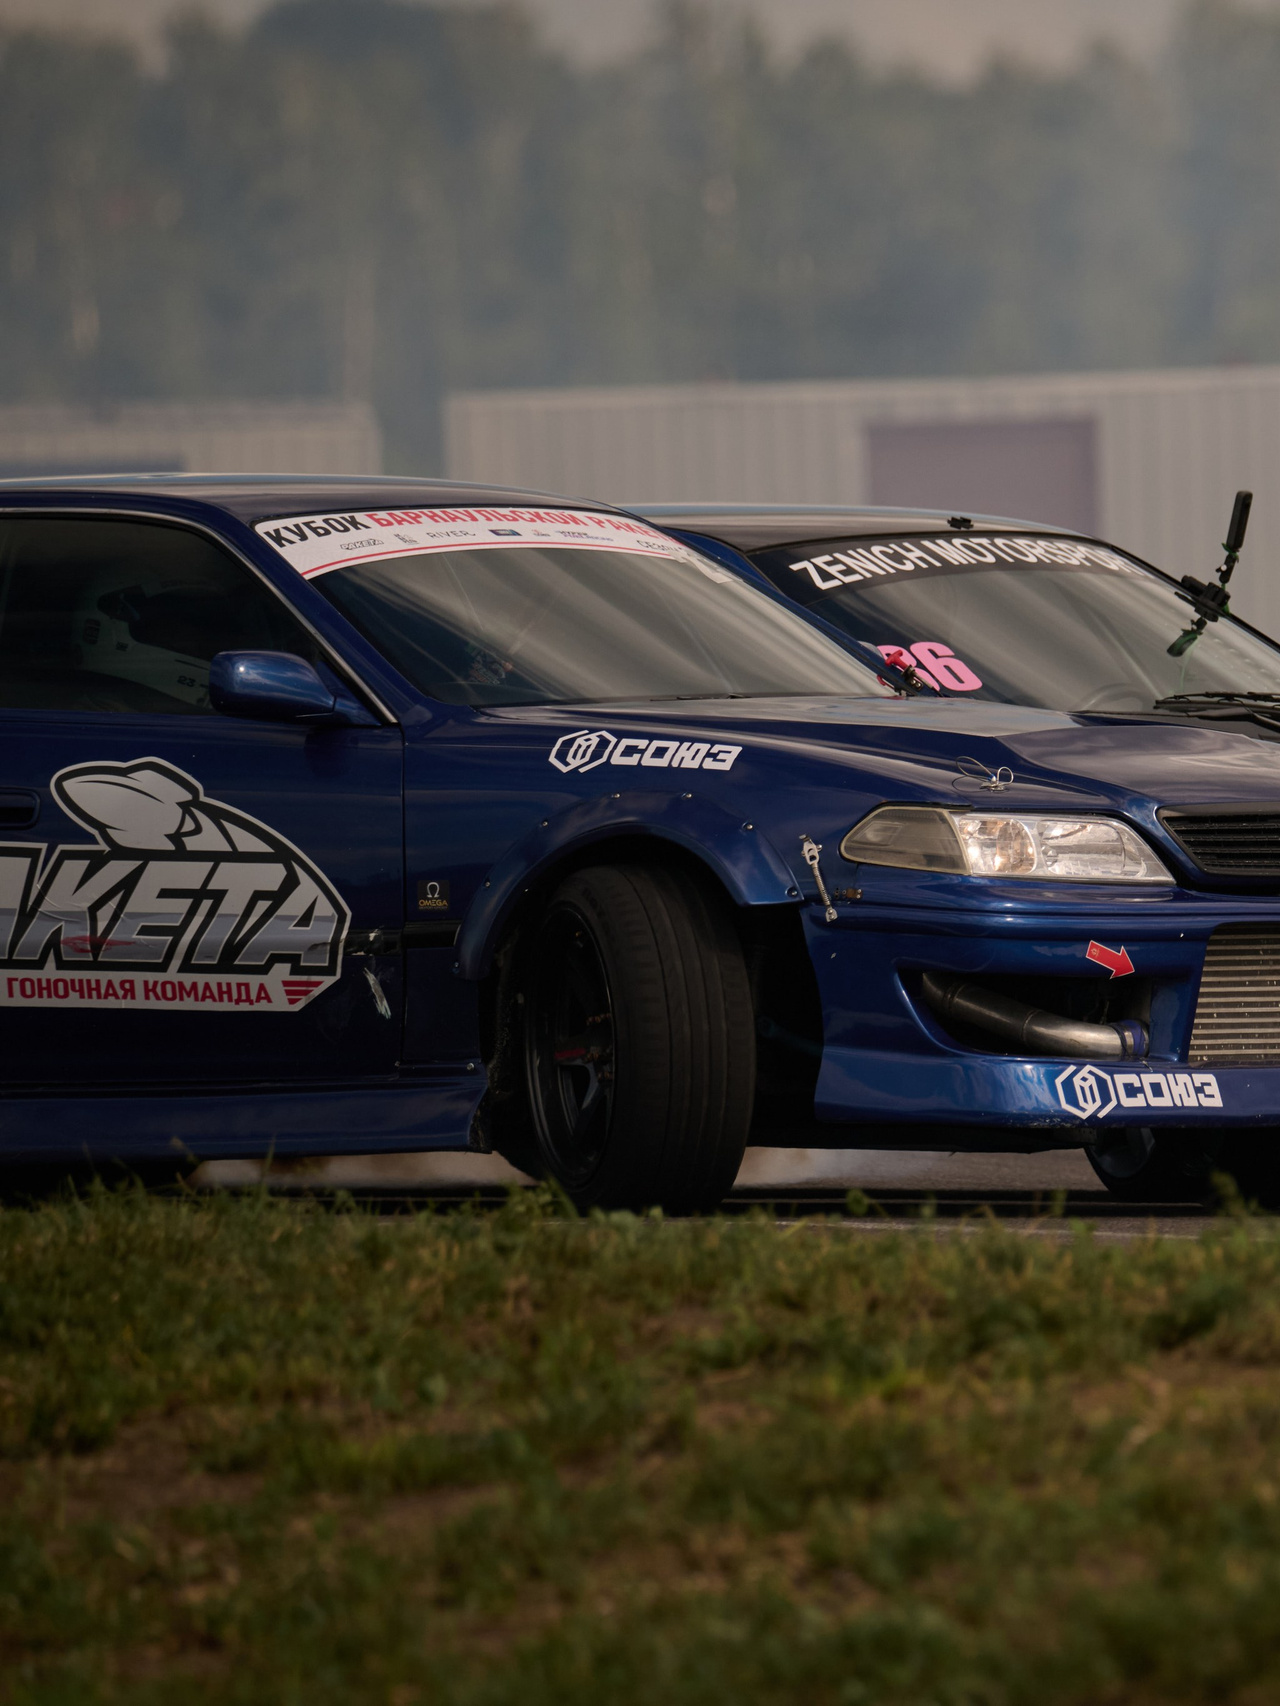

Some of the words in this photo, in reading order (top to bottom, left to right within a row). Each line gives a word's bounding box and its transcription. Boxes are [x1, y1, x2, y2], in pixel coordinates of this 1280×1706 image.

[263, 514, 372, 548] КУБОК
[365, 508, 588, 528] БАРНАУЛЬСКОЙ
[789, 541, 942, 590] ZENICH
[921, 537, 1155, 579] MOTORSPORT
[610, 738, 743, 770] СОЮЗ
[418, 899, 448, 907] OMEGA
[6, 977, 136, 1001] ГОНОЧНАЯ
[143, 980, 273, 1006] КОМАНДА
[1113, 1073, 1224, 1108] СОЮЗ
